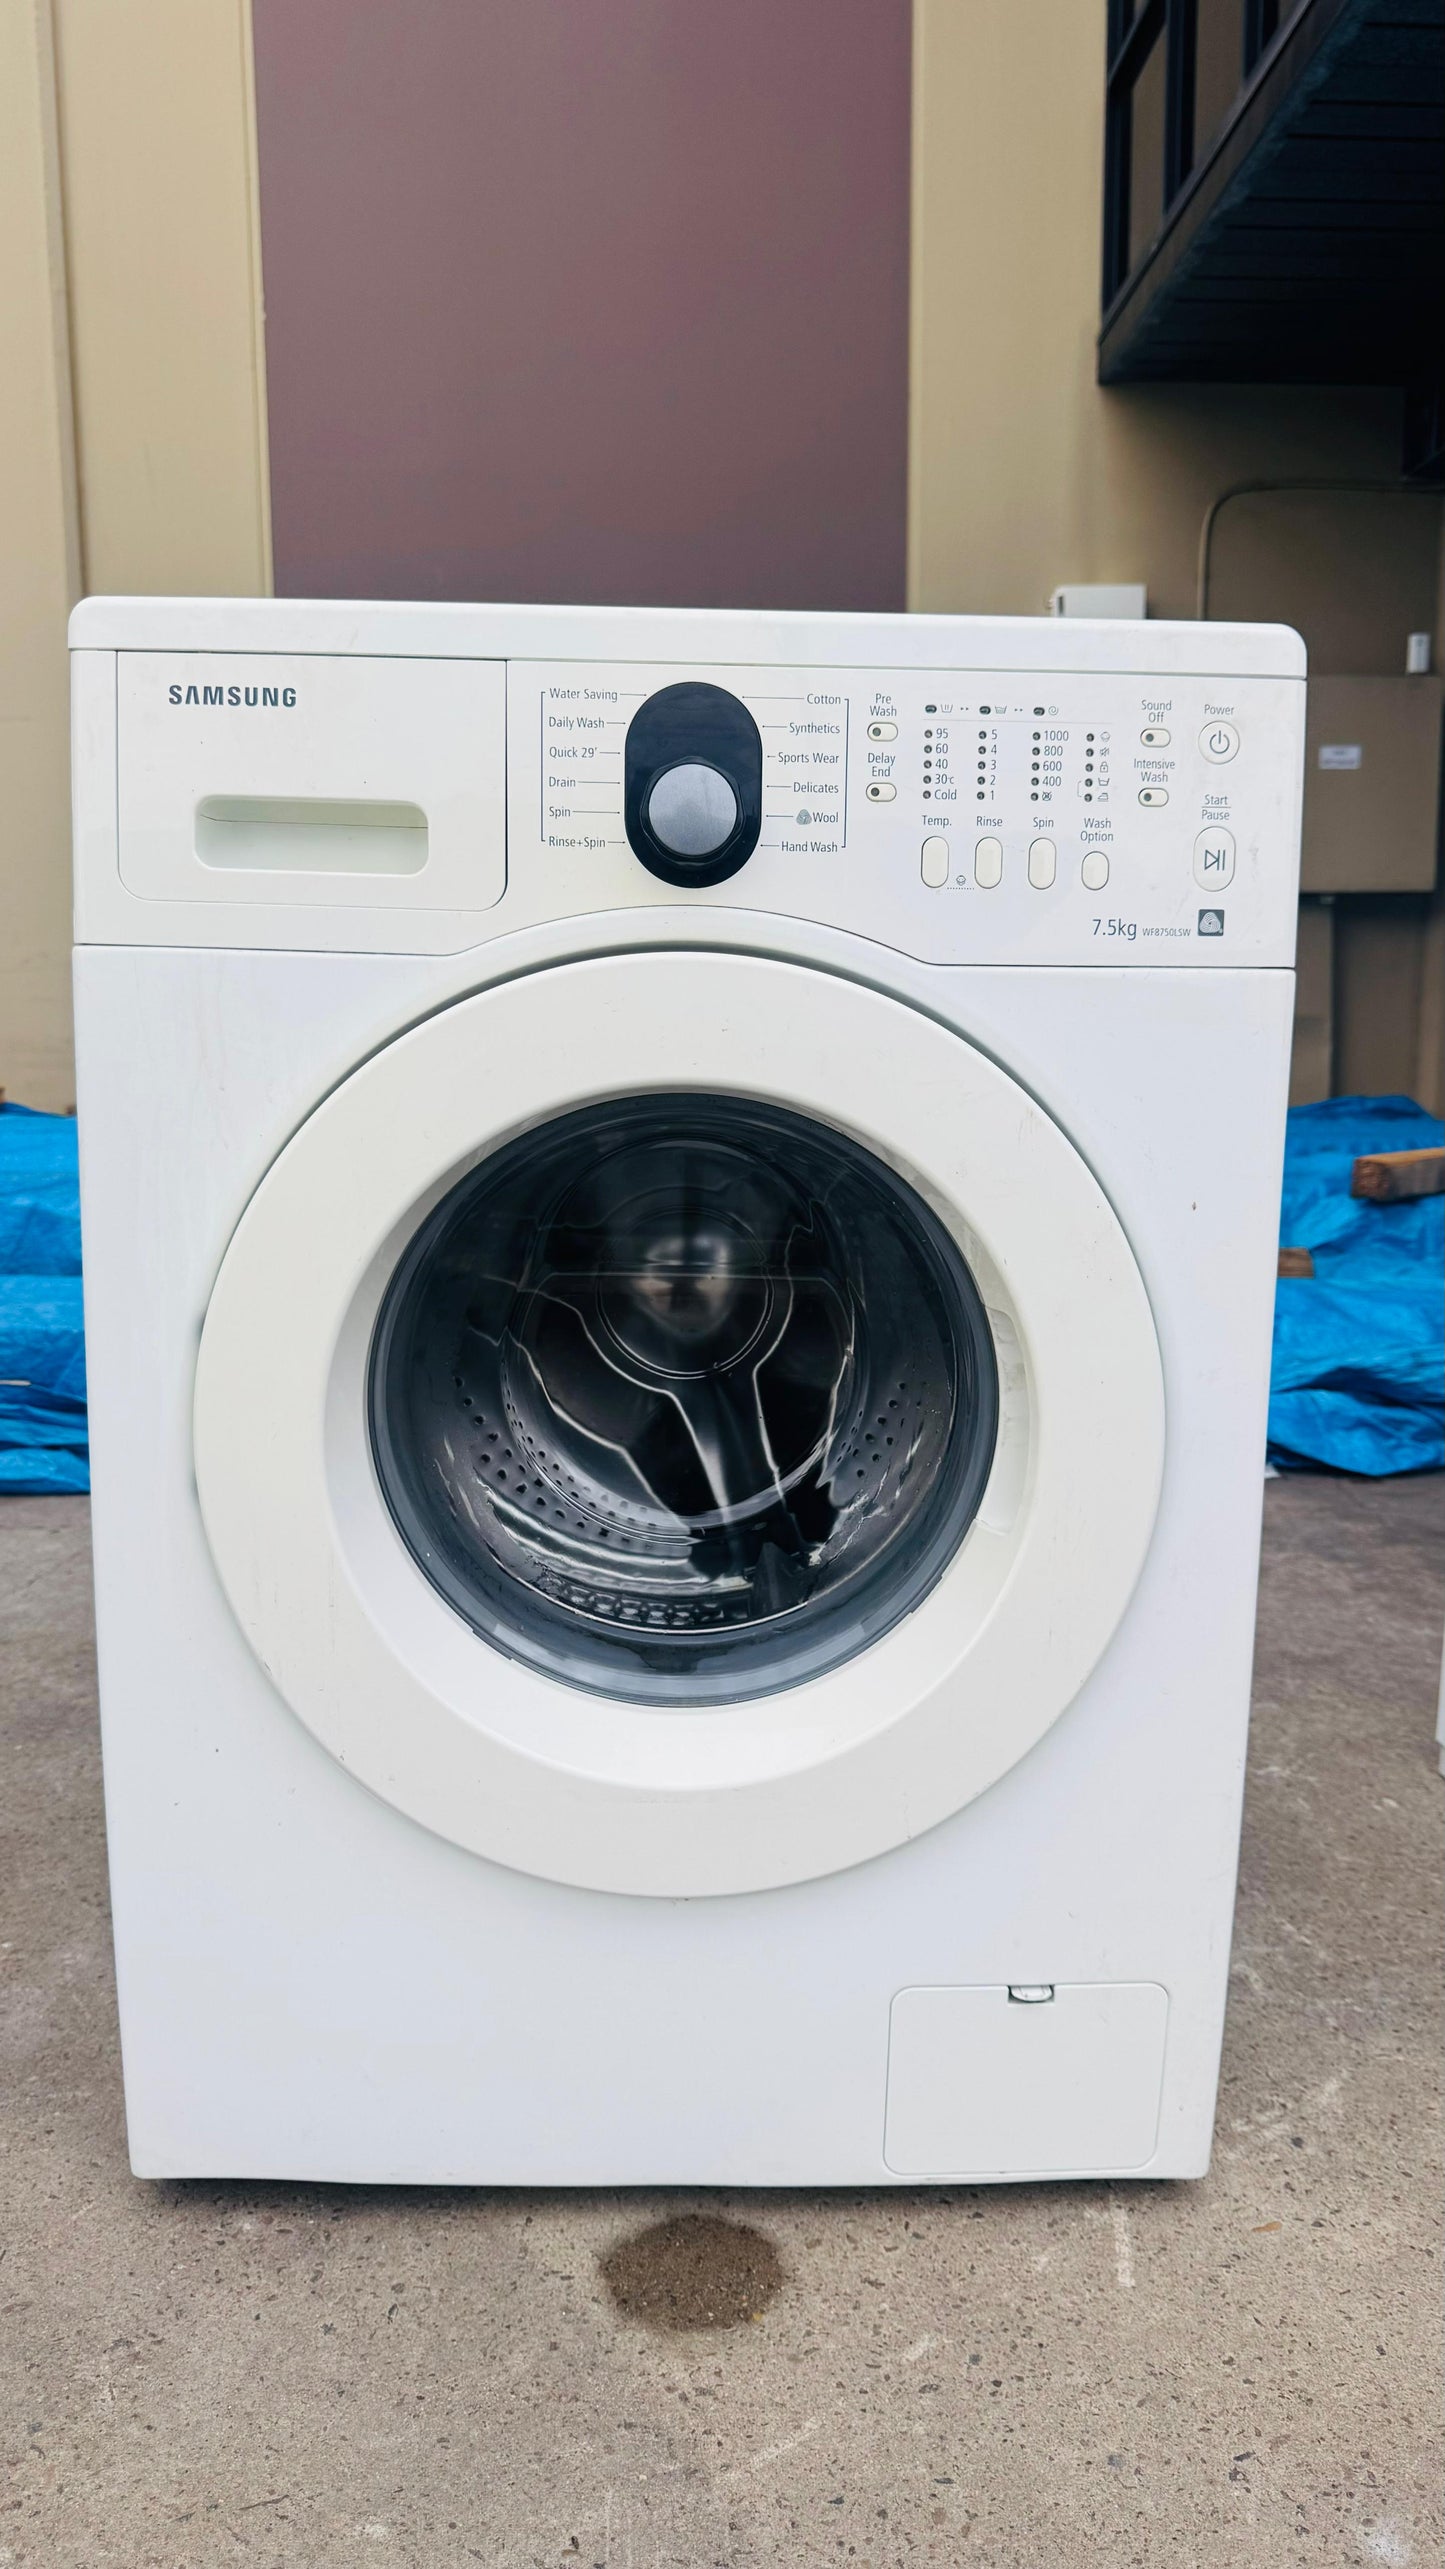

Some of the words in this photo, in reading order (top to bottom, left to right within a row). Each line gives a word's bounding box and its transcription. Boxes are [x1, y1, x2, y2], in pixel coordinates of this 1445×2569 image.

[169, 685, 296, 707] SAMSUNG
[549, 688, 581, 700] Water
[584, 689, 617, 703] Saving
[807, 693, 841, 704] Cotton
[876, 693, 891, 704] Pre
[870, 705, 897, 716] Wash
[1142, 700, 1172, 711] Sound
[1204, 704, 1234, 715] Power
[549, 716, 574, 730] Daily
[577, 717, 604, 728] Wash
[1148, 712, 1164, 723] Off
[790, 722, 840, 736] Synthetics
[936, 728, 948, 739] 95
[991, 729, 998, 740] 5
[1044, 730, 1069, 741] 1000
[549, 747, 578, 759] Quick
[936, 743, 948, 754] 60
[991, 744, 997, 754] 4
[1044, 745, 1063, 756] 800
[779, 752, 809, 765] Sports
[813, 753, 839, 763] Wear
[868, 752, 896, 766] Delay
[935, 759, 948, 769] 40
[1134, 758, 1175, 769] Intensive
[990, 759, 997, 770] 3
[1043, 761, 1062, 771] 600
[872, 766, 890, 777] End
[1141, 771, 1168, 782] Wash
[549, 776, 576, 787] Drain
[990, 775, 996, 785] 2
[1042, 776, 1061, 786] 400
[794, 782, 839, 793] Delicates
[935, 789, 957, 800] Cold
[1205, 794, 1228, 806] Start
[549, 806, 570, 819] Spin
[811, 812, 838, 823] Wool
[1202, 810, 1230, 821] Pause
[922, 815, 951, 828] Temp.
[977, 816, 1002, 826] Rinse
[1033, 817, 1054, 830] Spin
[1084, 818, 1111, 829] Wash
[549, 836, 605, 850] Rinse+Spin
[1080, 831, 1113, 844] Option
[782, 841, 807, 852] Hand
[811, 842, 837, 852] Wash
[1093, 919, 1136, 940] 7.5kg
